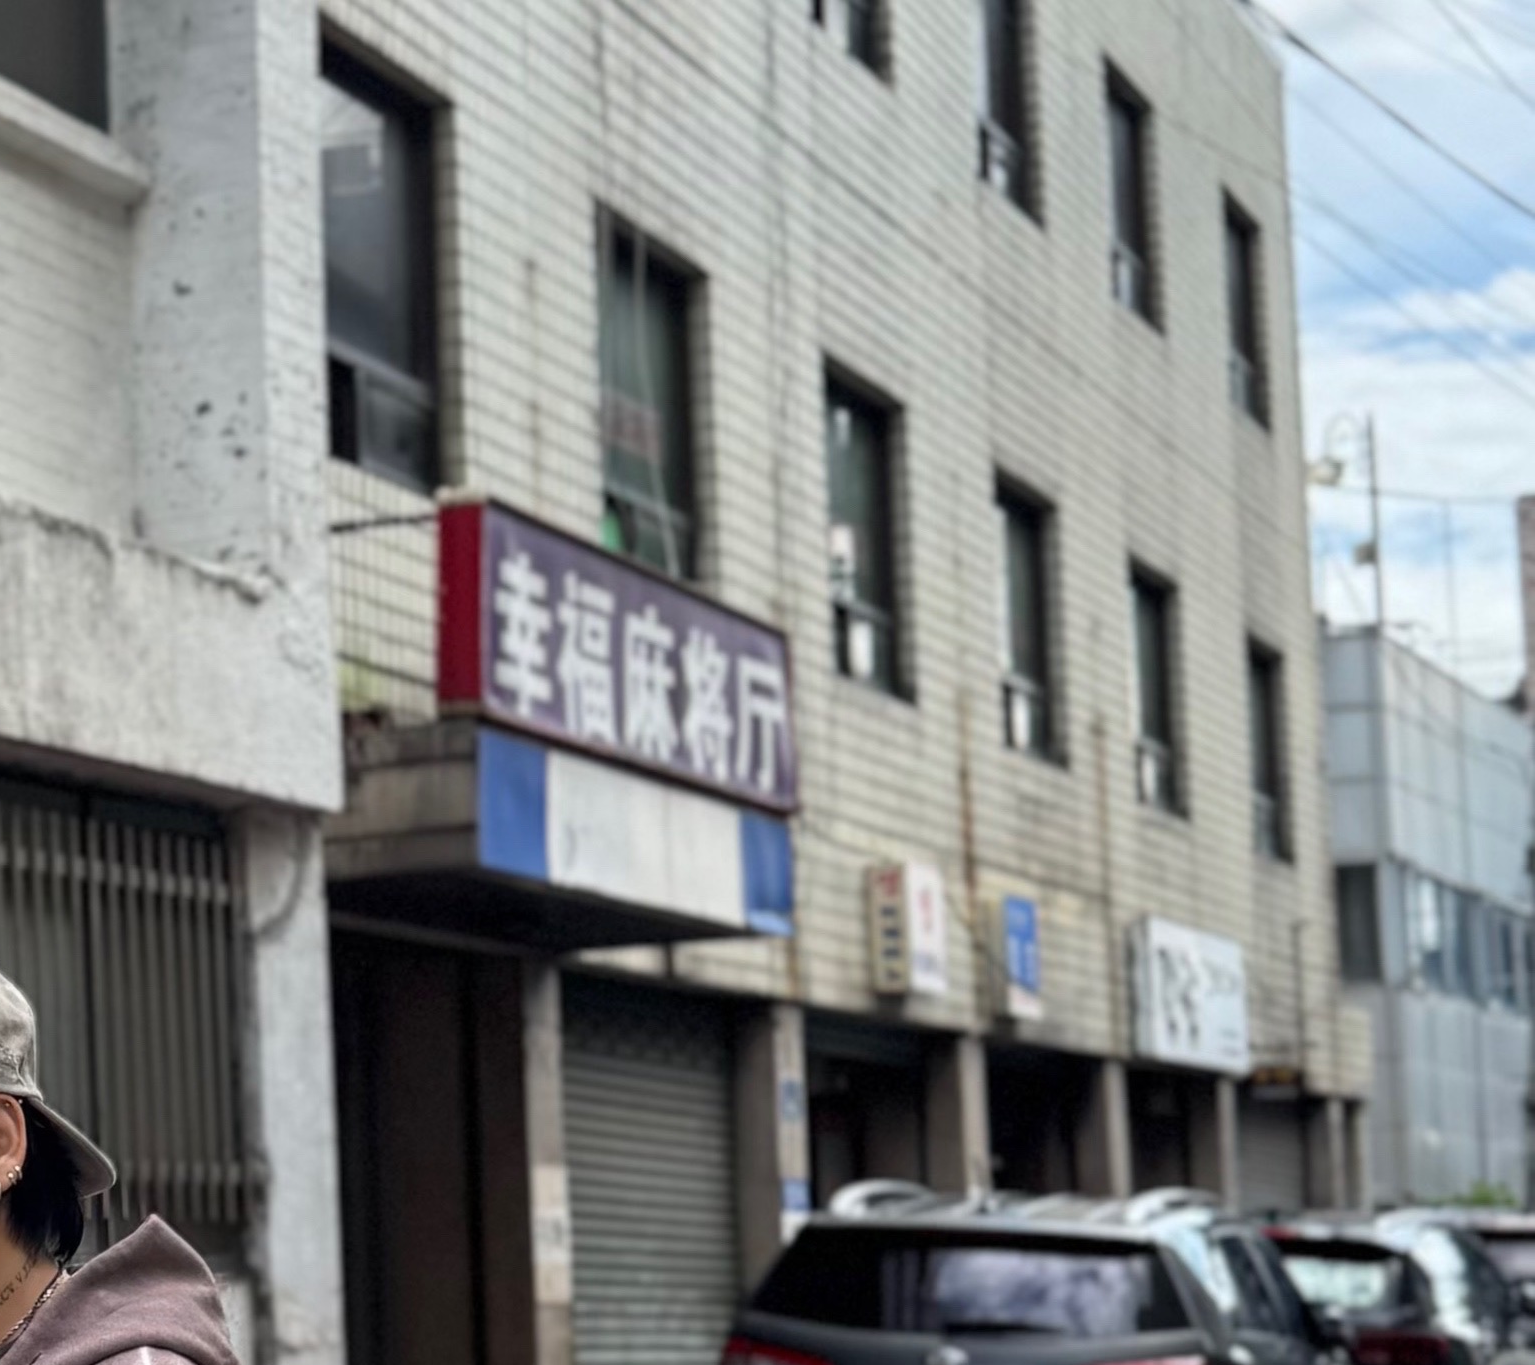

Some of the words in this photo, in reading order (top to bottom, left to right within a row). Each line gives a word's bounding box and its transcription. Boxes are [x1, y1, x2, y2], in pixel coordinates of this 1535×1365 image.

[494, 551, 786, 792] 幸福麻将厅
